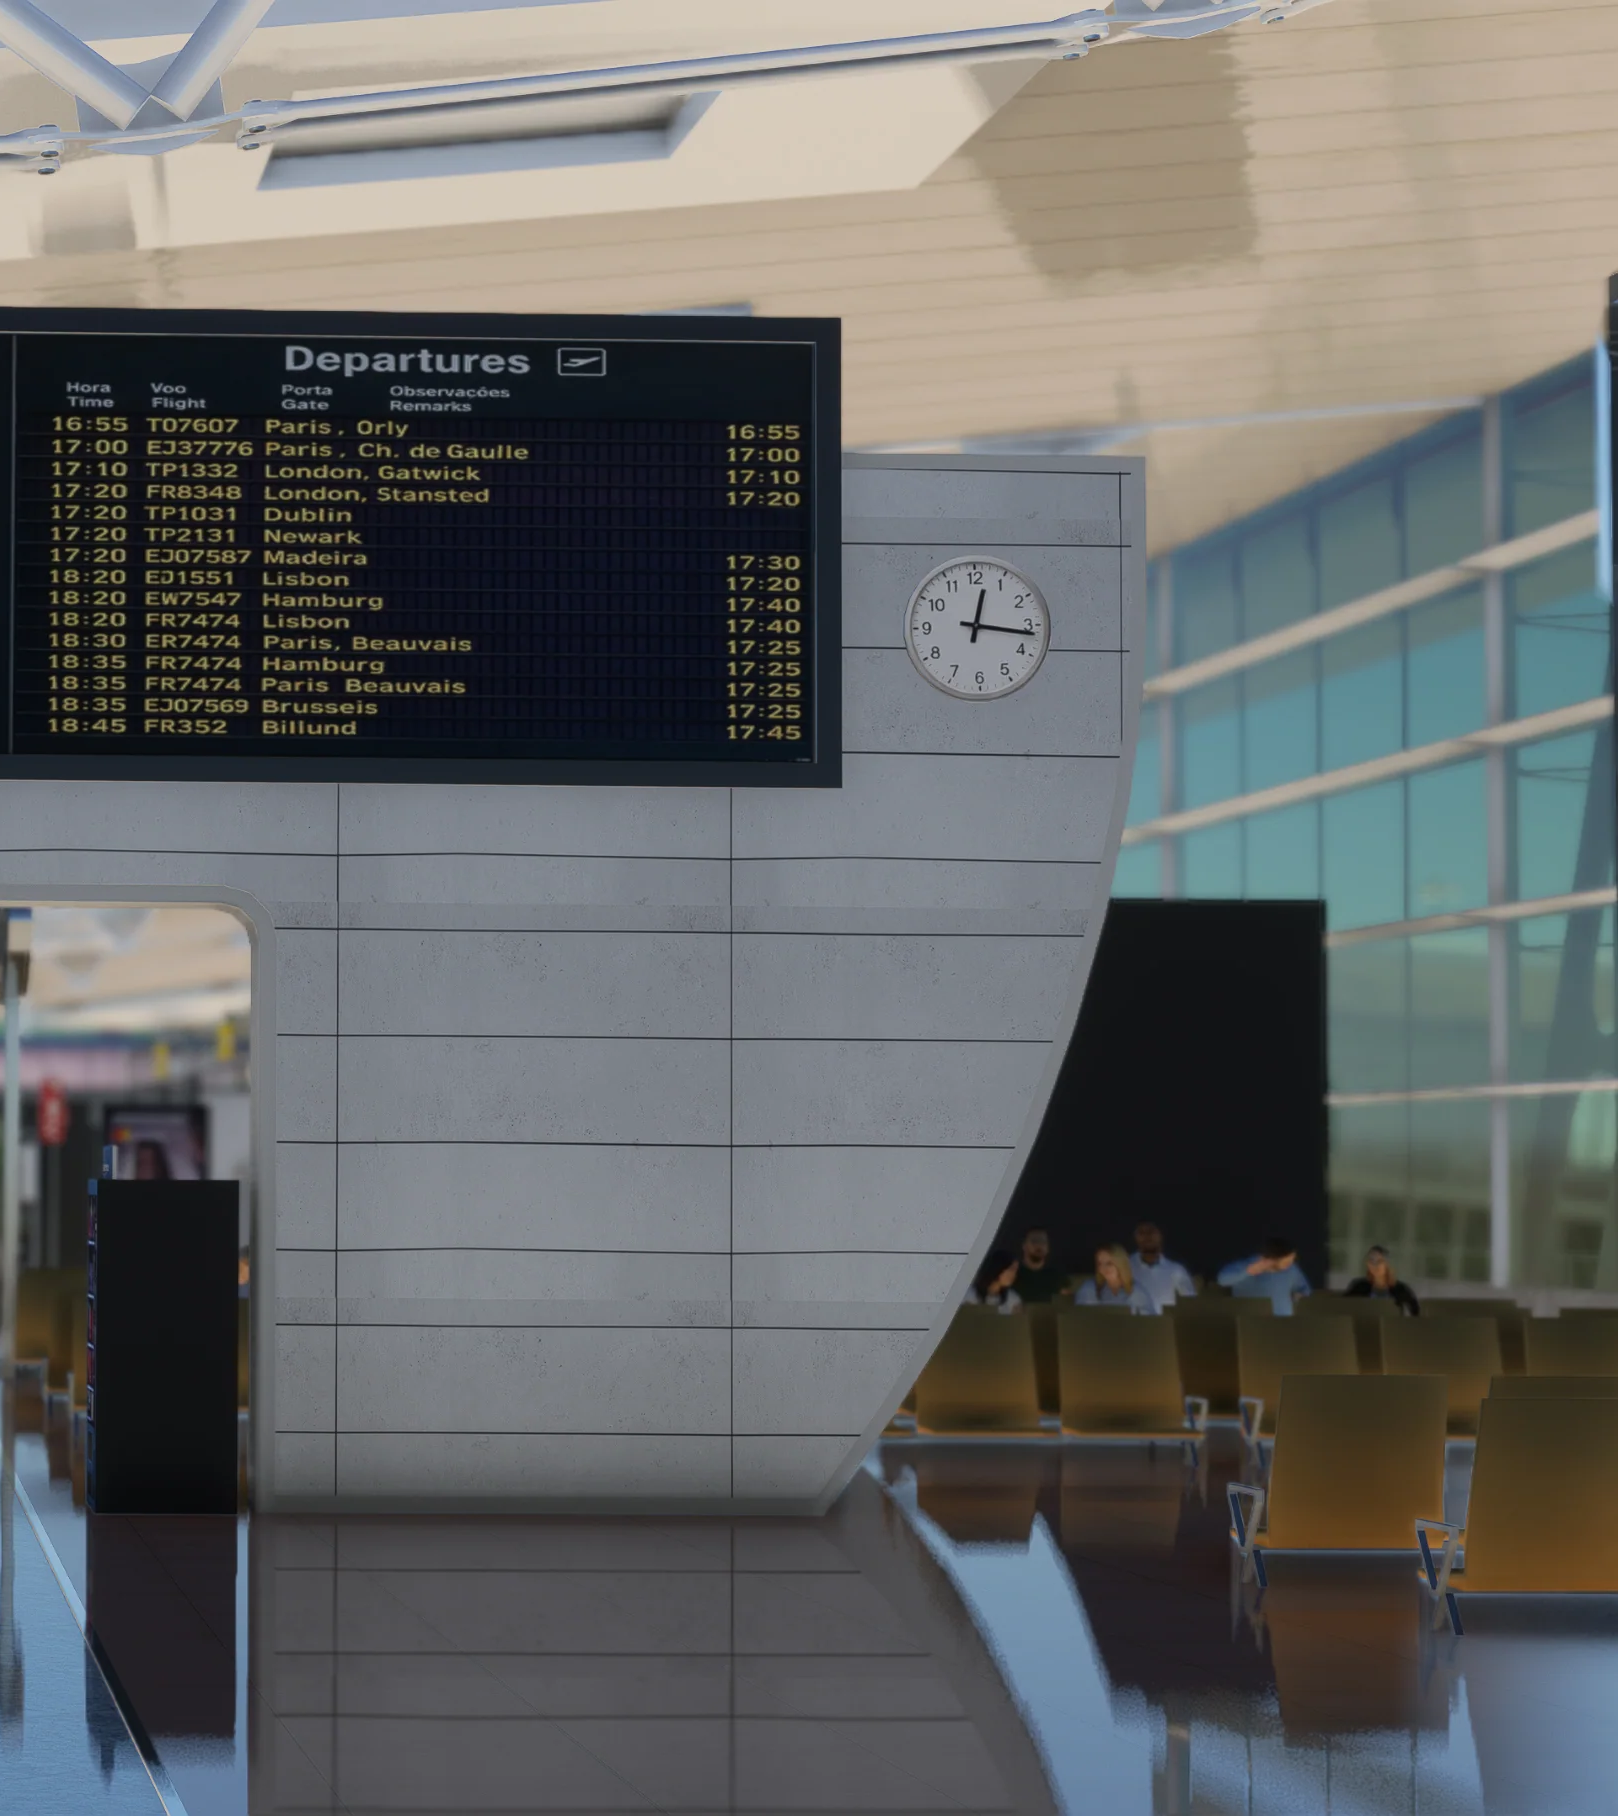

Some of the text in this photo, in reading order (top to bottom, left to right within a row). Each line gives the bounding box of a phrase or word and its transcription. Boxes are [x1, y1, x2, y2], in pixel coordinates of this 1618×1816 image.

[284, 345, 531, 378] Departures
[65, 382, 111, 393] Hora
[149, 382, 187, 394] Voo
[280, 384, 333, 396] Porta
[66, 396, 472, 412] Time Flight Gate Remarks
[52, 416, 128, 432] 16:55
[356, 420, 408, 438] Orly
[727, 424, 800, 440] 16:55
[52, 439, 128, 455] 17:00
[146, 440, 253, 456] EJ37776
[356, 443, 401, 459] Ch.
[408, 443, 441, 459] de
[446, 444, 529, 460] Gaulle
[726, 447, 800, 463] 17:00
[51, 461, 800, 485] 17:10 TP1332 London, Gatwick 17:10
[52, 483, 800, 506] 17:20 FR8348 London, Stansted 17:20
[51, 505, 352, 522] 17:20 TP1031 Dublin
[51, 526, 361, 544] 17:20 TP2131 Newark
[50, 548, 800, 571] 17:20 EJ07587 Madeira 17:30
[49, 569, 800, 592] 18:20 Lisbon 17:20
[947, 580, 958, 592] 11
[967, 572, 983, 584] 12
[998, 579, 1002, 591] 1
[49, 590, 801, 613] 18:20 EW7547 Hamburg 17:40
[929, 599, 945, 611] 10
[1014, 595, 1024, 608] 2
[922, 622, 931, 635] 9
[1024, 619, 1033, 631] 3
[49, 633, 126, 648] 18:30
[145, 634, 241, 649] ER7474
[351, 636, 471, 651] Beauvais
[727, 640, 801, 655] 17:25
[1016, 643, 1025, 655] 4
[931, 647, 940, 659] 8
[950, 665, 958, 677] 7
[1000, 663, 1009, 675] 5
[975, 672, 984, 684] 6
[48, 697, 126, 712] 18:35
[144, 698, 249, 713] EJ07569
[726, 704, 801, 719] 17:25
[48, 718, 801, 740] 18:45 FR352 Billund 17:45
